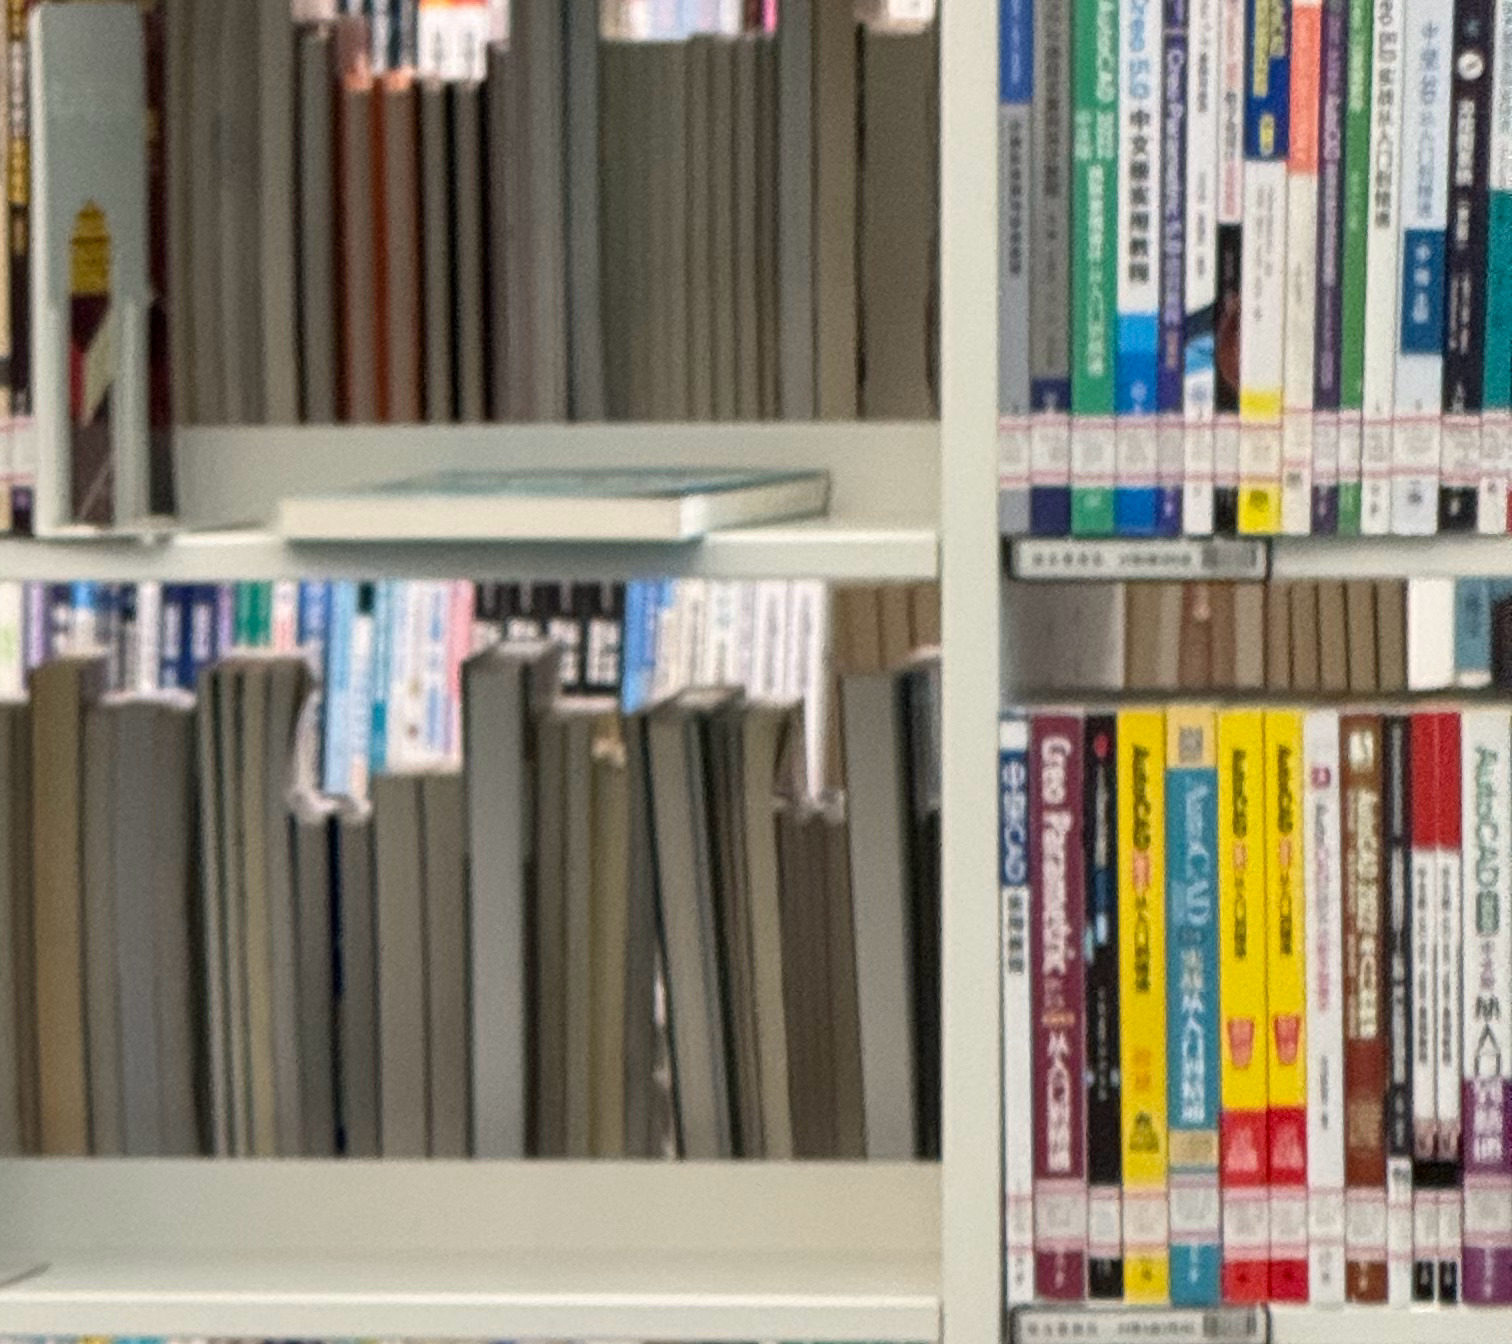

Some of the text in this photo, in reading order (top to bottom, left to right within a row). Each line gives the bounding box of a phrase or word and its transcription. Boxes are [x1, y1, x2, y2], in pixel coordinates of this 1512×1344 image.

[1041, 736, 1073, 804] Creo
[1473, 746, 1498, 892] AutoCAD
[1042, 811, 1076, 976] Parametric
